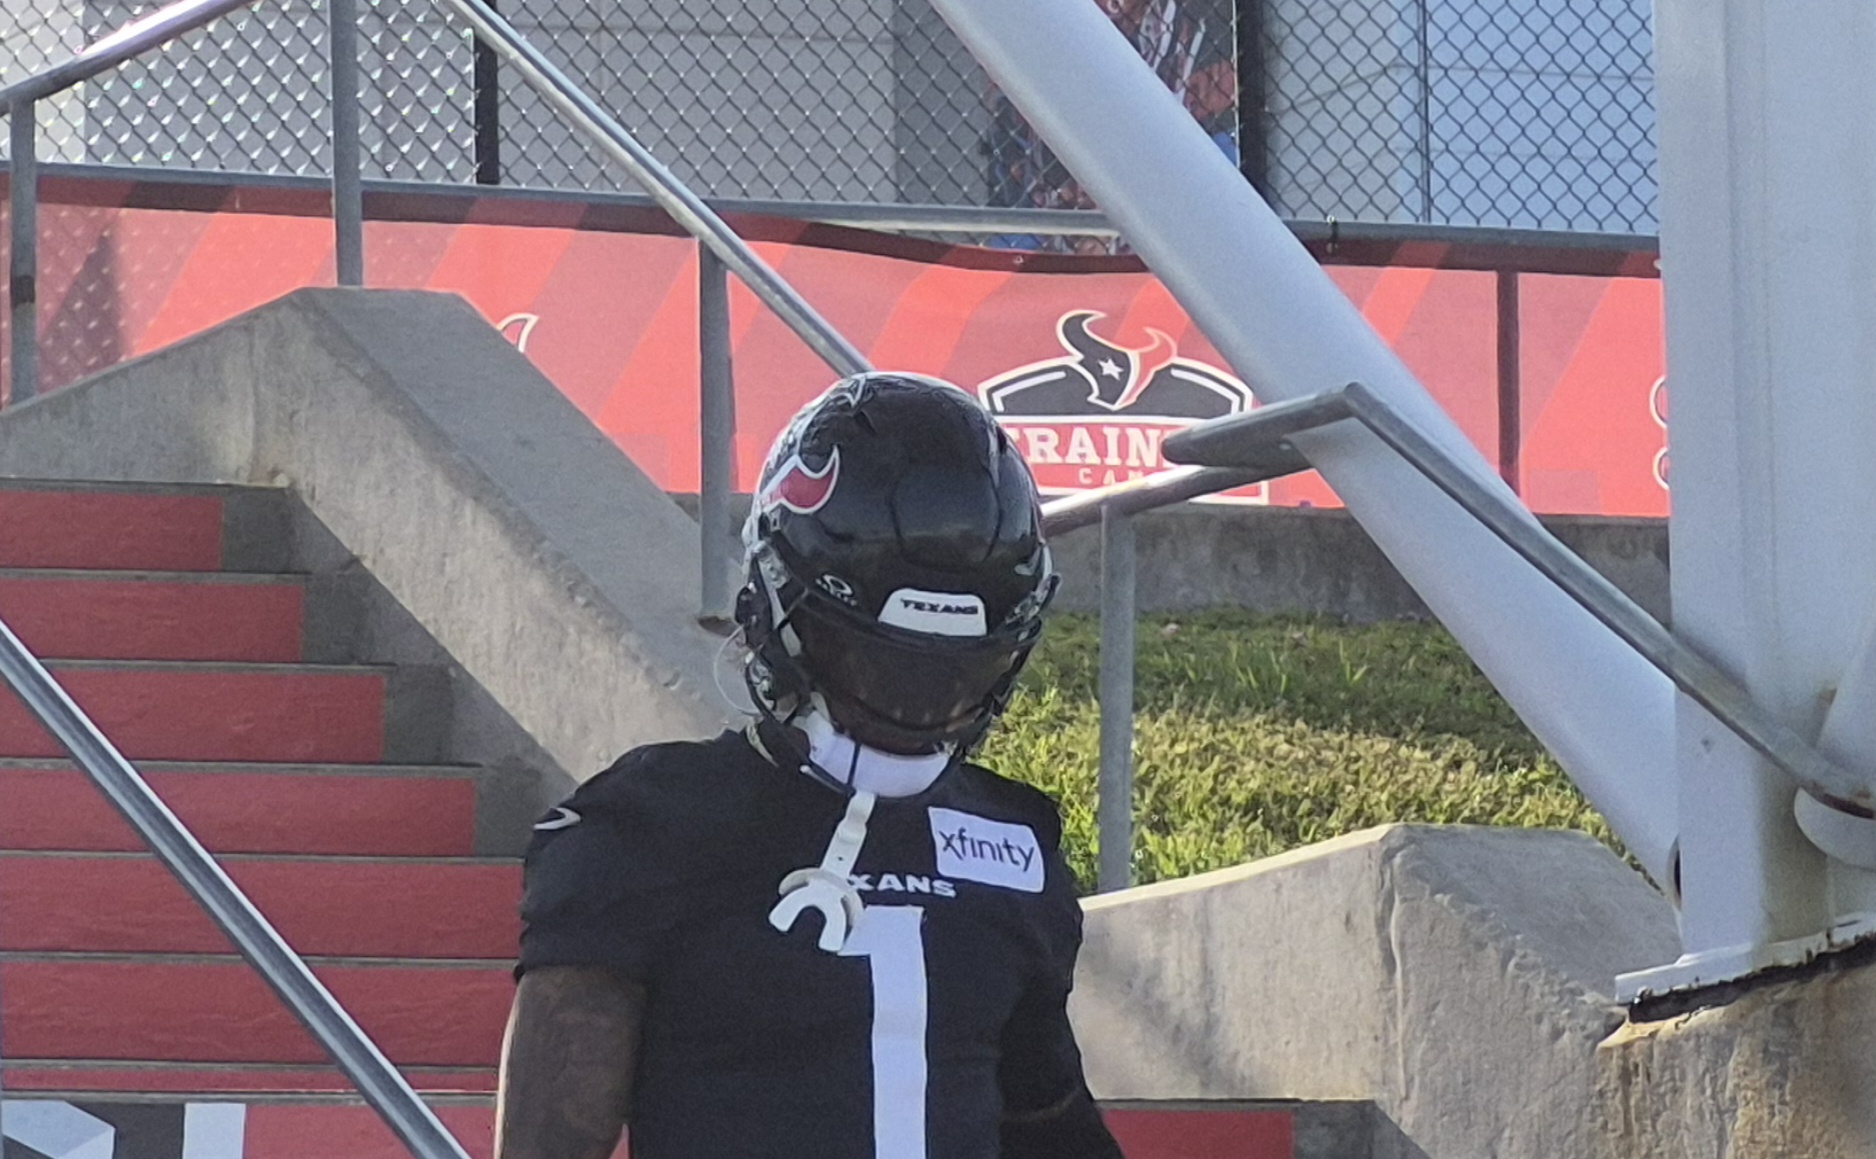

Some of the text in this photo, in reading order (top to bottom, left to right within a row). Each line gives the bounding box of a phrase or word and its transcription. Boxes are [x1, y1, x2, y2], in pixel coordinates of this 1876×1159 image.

[1004, 426, 1180, 468] RAIN
[900, 598, 979, 616] TEXANS
[938, 827, 1035, 872] xfinity
[847, 873, 957, 898] XANS
